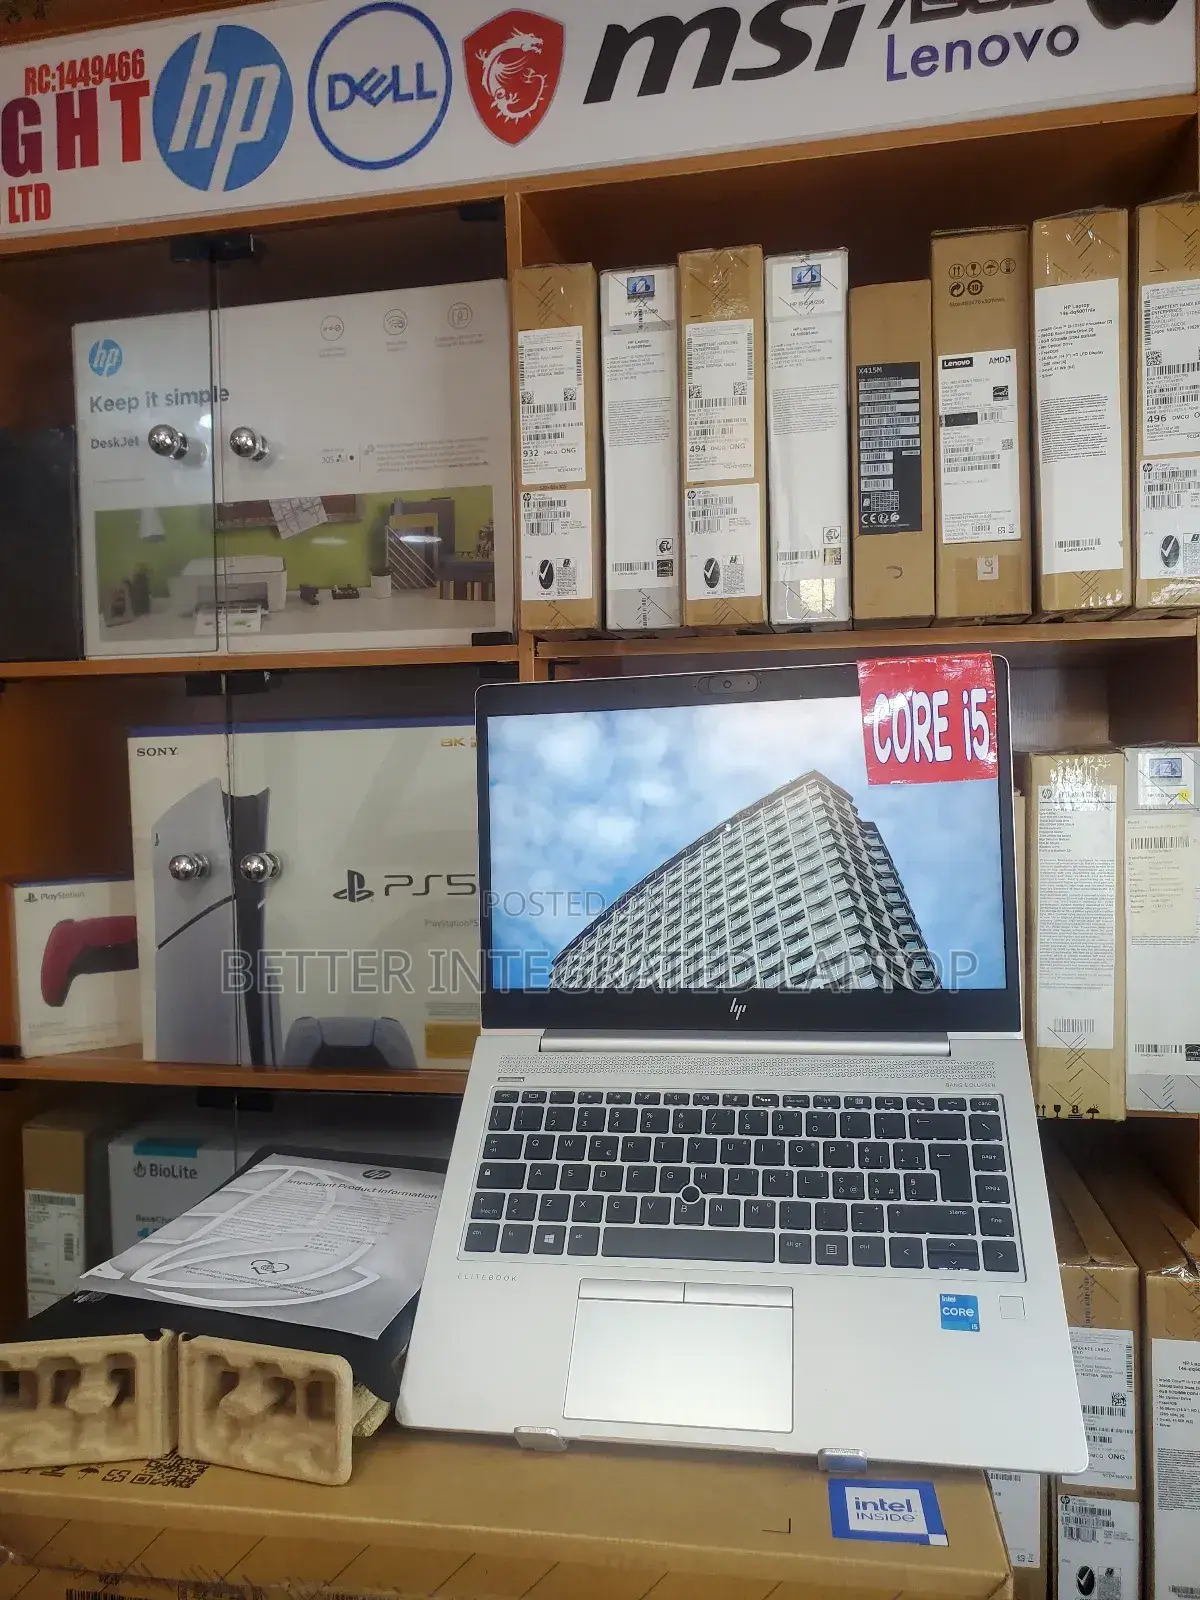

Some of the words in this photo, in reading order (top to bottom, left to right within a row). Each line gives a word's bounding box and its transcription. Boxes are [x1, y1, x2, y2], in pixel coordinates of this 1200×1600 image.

[583, 0, 868, 104] msi
[885, 23, 1080, 81] Lenovo
[24, 48, 145, 96] RC:1449466
[327, 61, 437, 113] DELL
[160, 25, 288, 192] hp
[8, 182, 52, 224] LTD
[90, 339, 123, 377] hp
[89, 395, 139, 413] Keep
[145, 390, 159, 408] it
[164, 385, 230, 407] simple
[1147, 414, 1166, 422] 496
[90, 435, 139, 450] DeskJet
[690, 444, 706, 452] 494
[872, 689, 953, 764] CORE
[962, 688, 990, 762] i5
[136, 746, 178, 758] SONY
[40, 891, 85, 901] PlayStation
[384, 874, 476, 896] PS5
[150, 1163, 198, 1180] BioLite
[287, 1178, 336, 1188] Important
[338, 1183, 377, 1194] Product
[377, 1187, 438, 1200] Information
[458, 1273, 517, 1282] ELITEBOOK
[854, 1497, 912, 1512] intel
